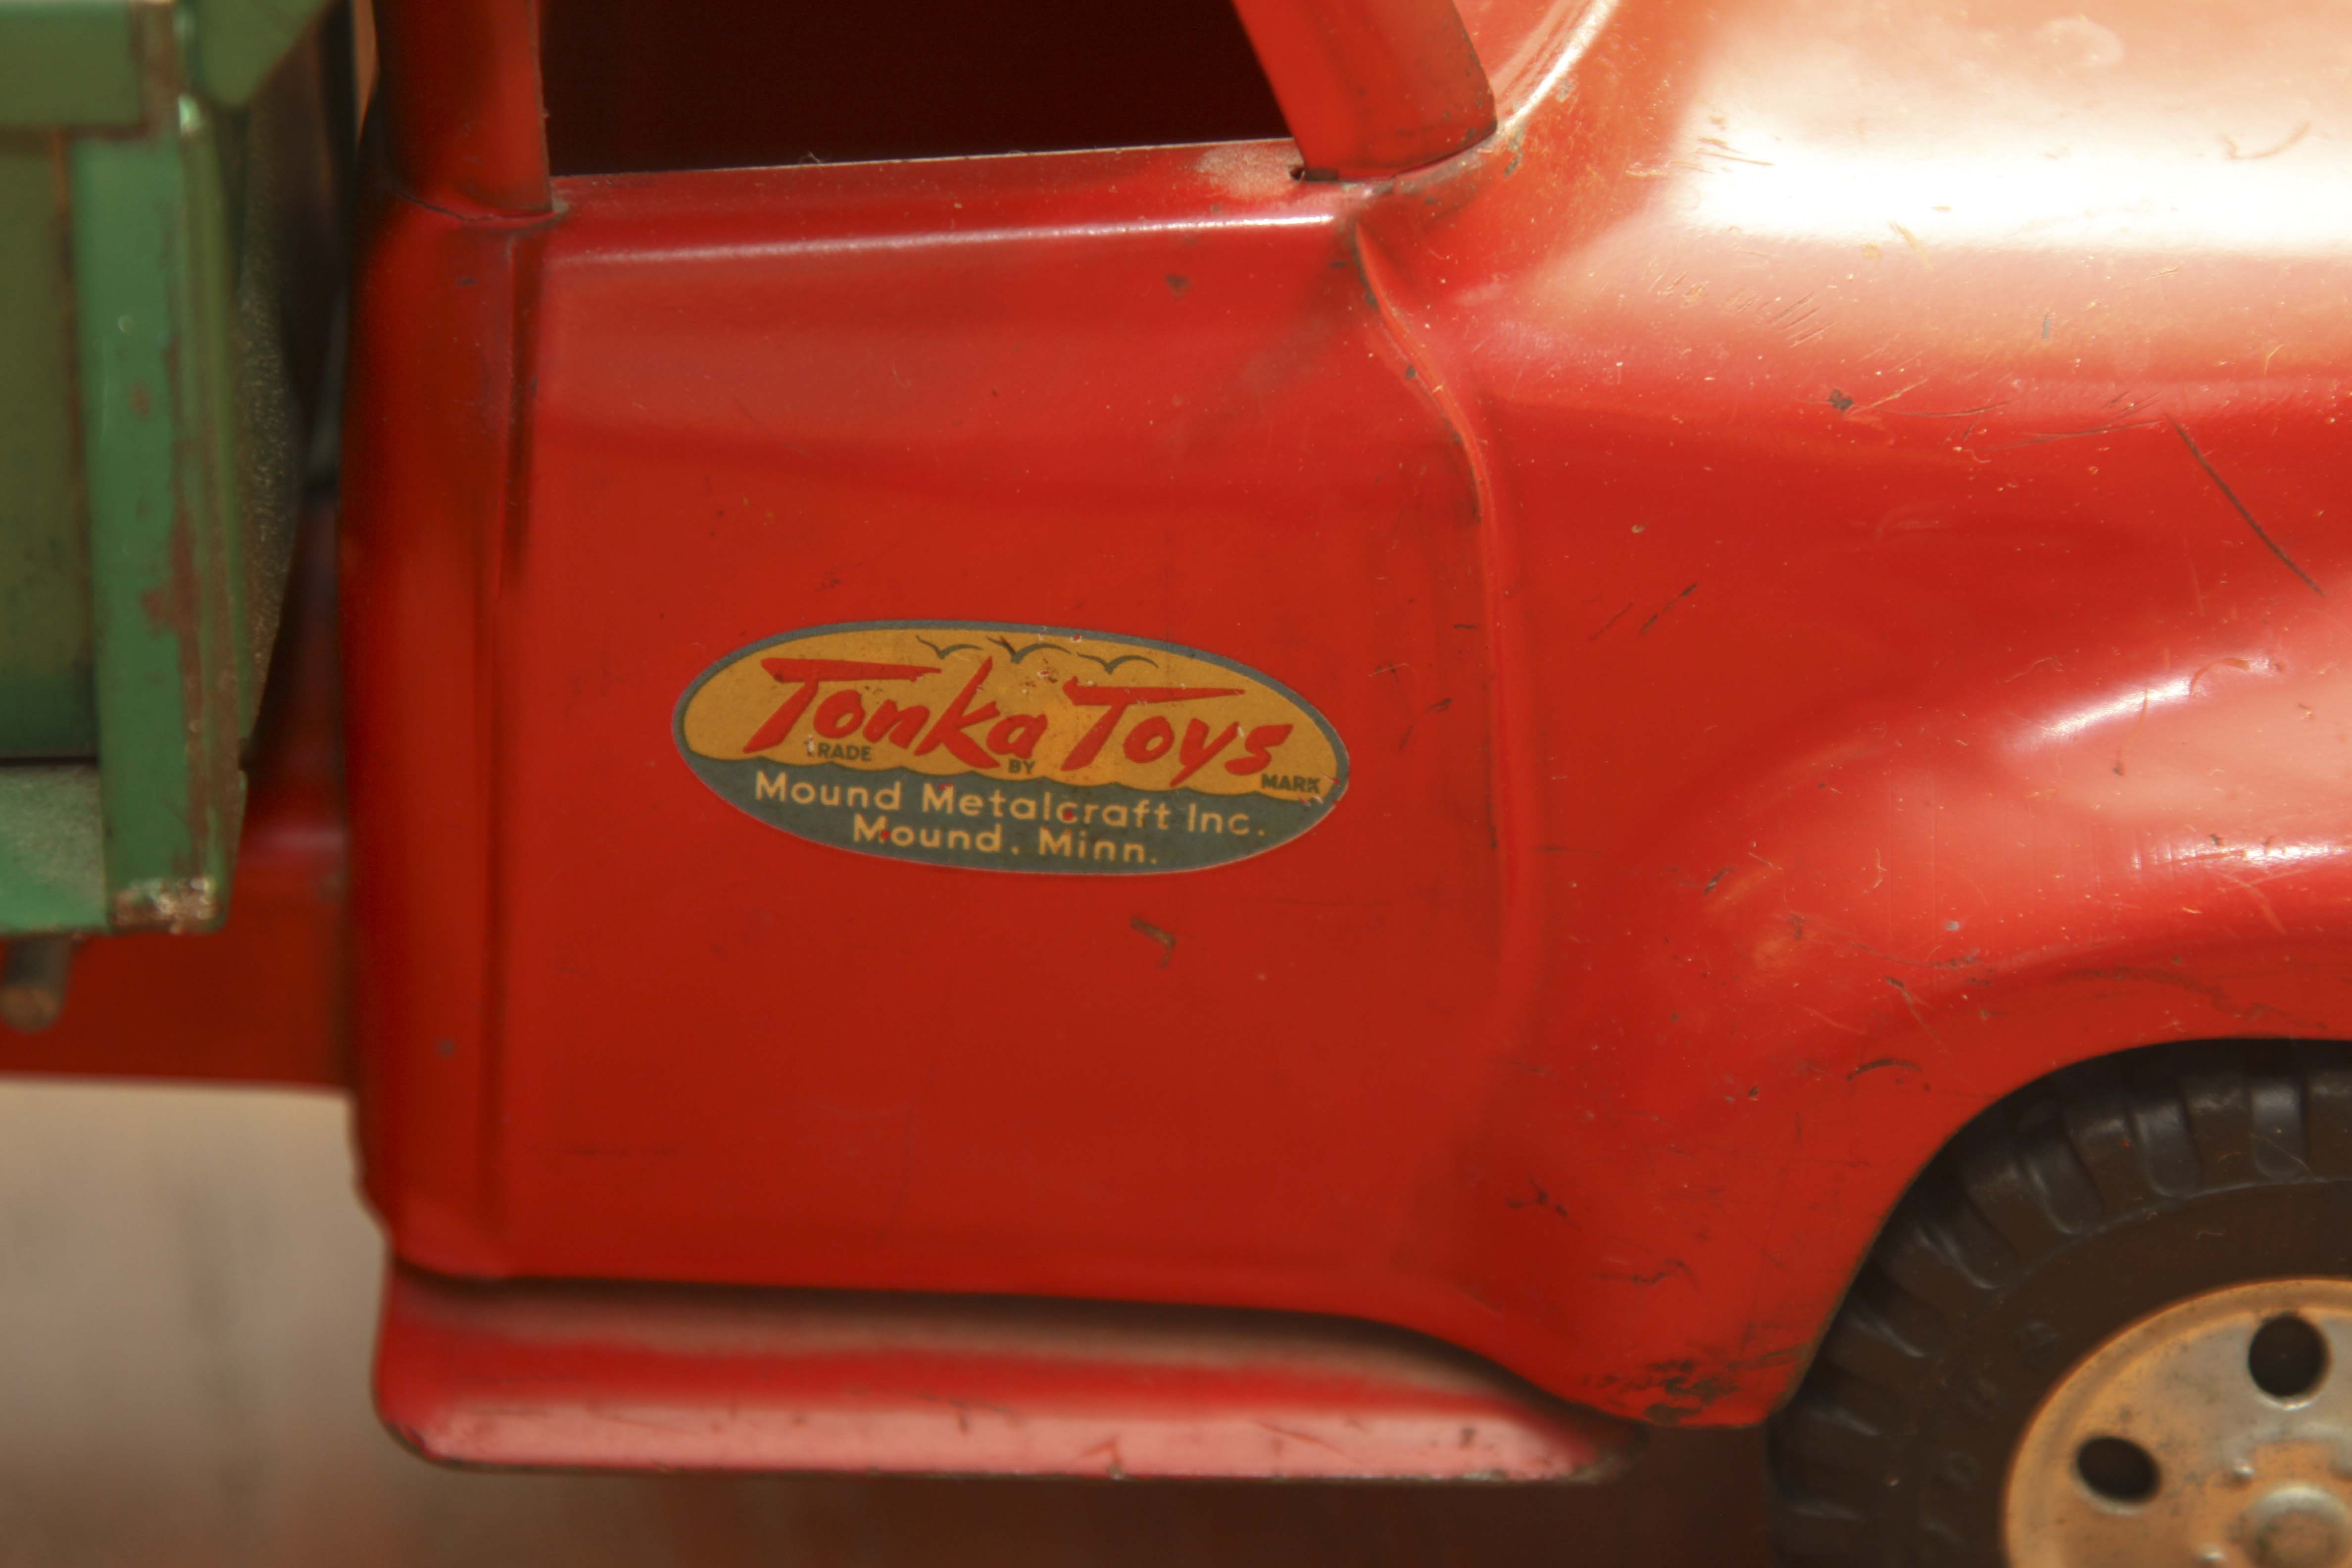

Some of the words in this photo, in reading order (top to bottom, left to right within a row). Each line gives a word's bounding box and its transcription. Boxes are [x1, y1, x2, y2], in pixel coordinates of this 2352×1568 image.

[742, 656, 1048, 769] Tonka
[1060, 676, 1293, 787] Toys
[1008, 759, 1036, 775] BY
[1261, 773, 1321, 794] MARK
[755, 770, 902, 811] Mound
[922, 783, 1171, 831] Metalcraft
[1187, 802, 1266, 837] Inc.
[1039, 826, 1159, 865] Minn.
